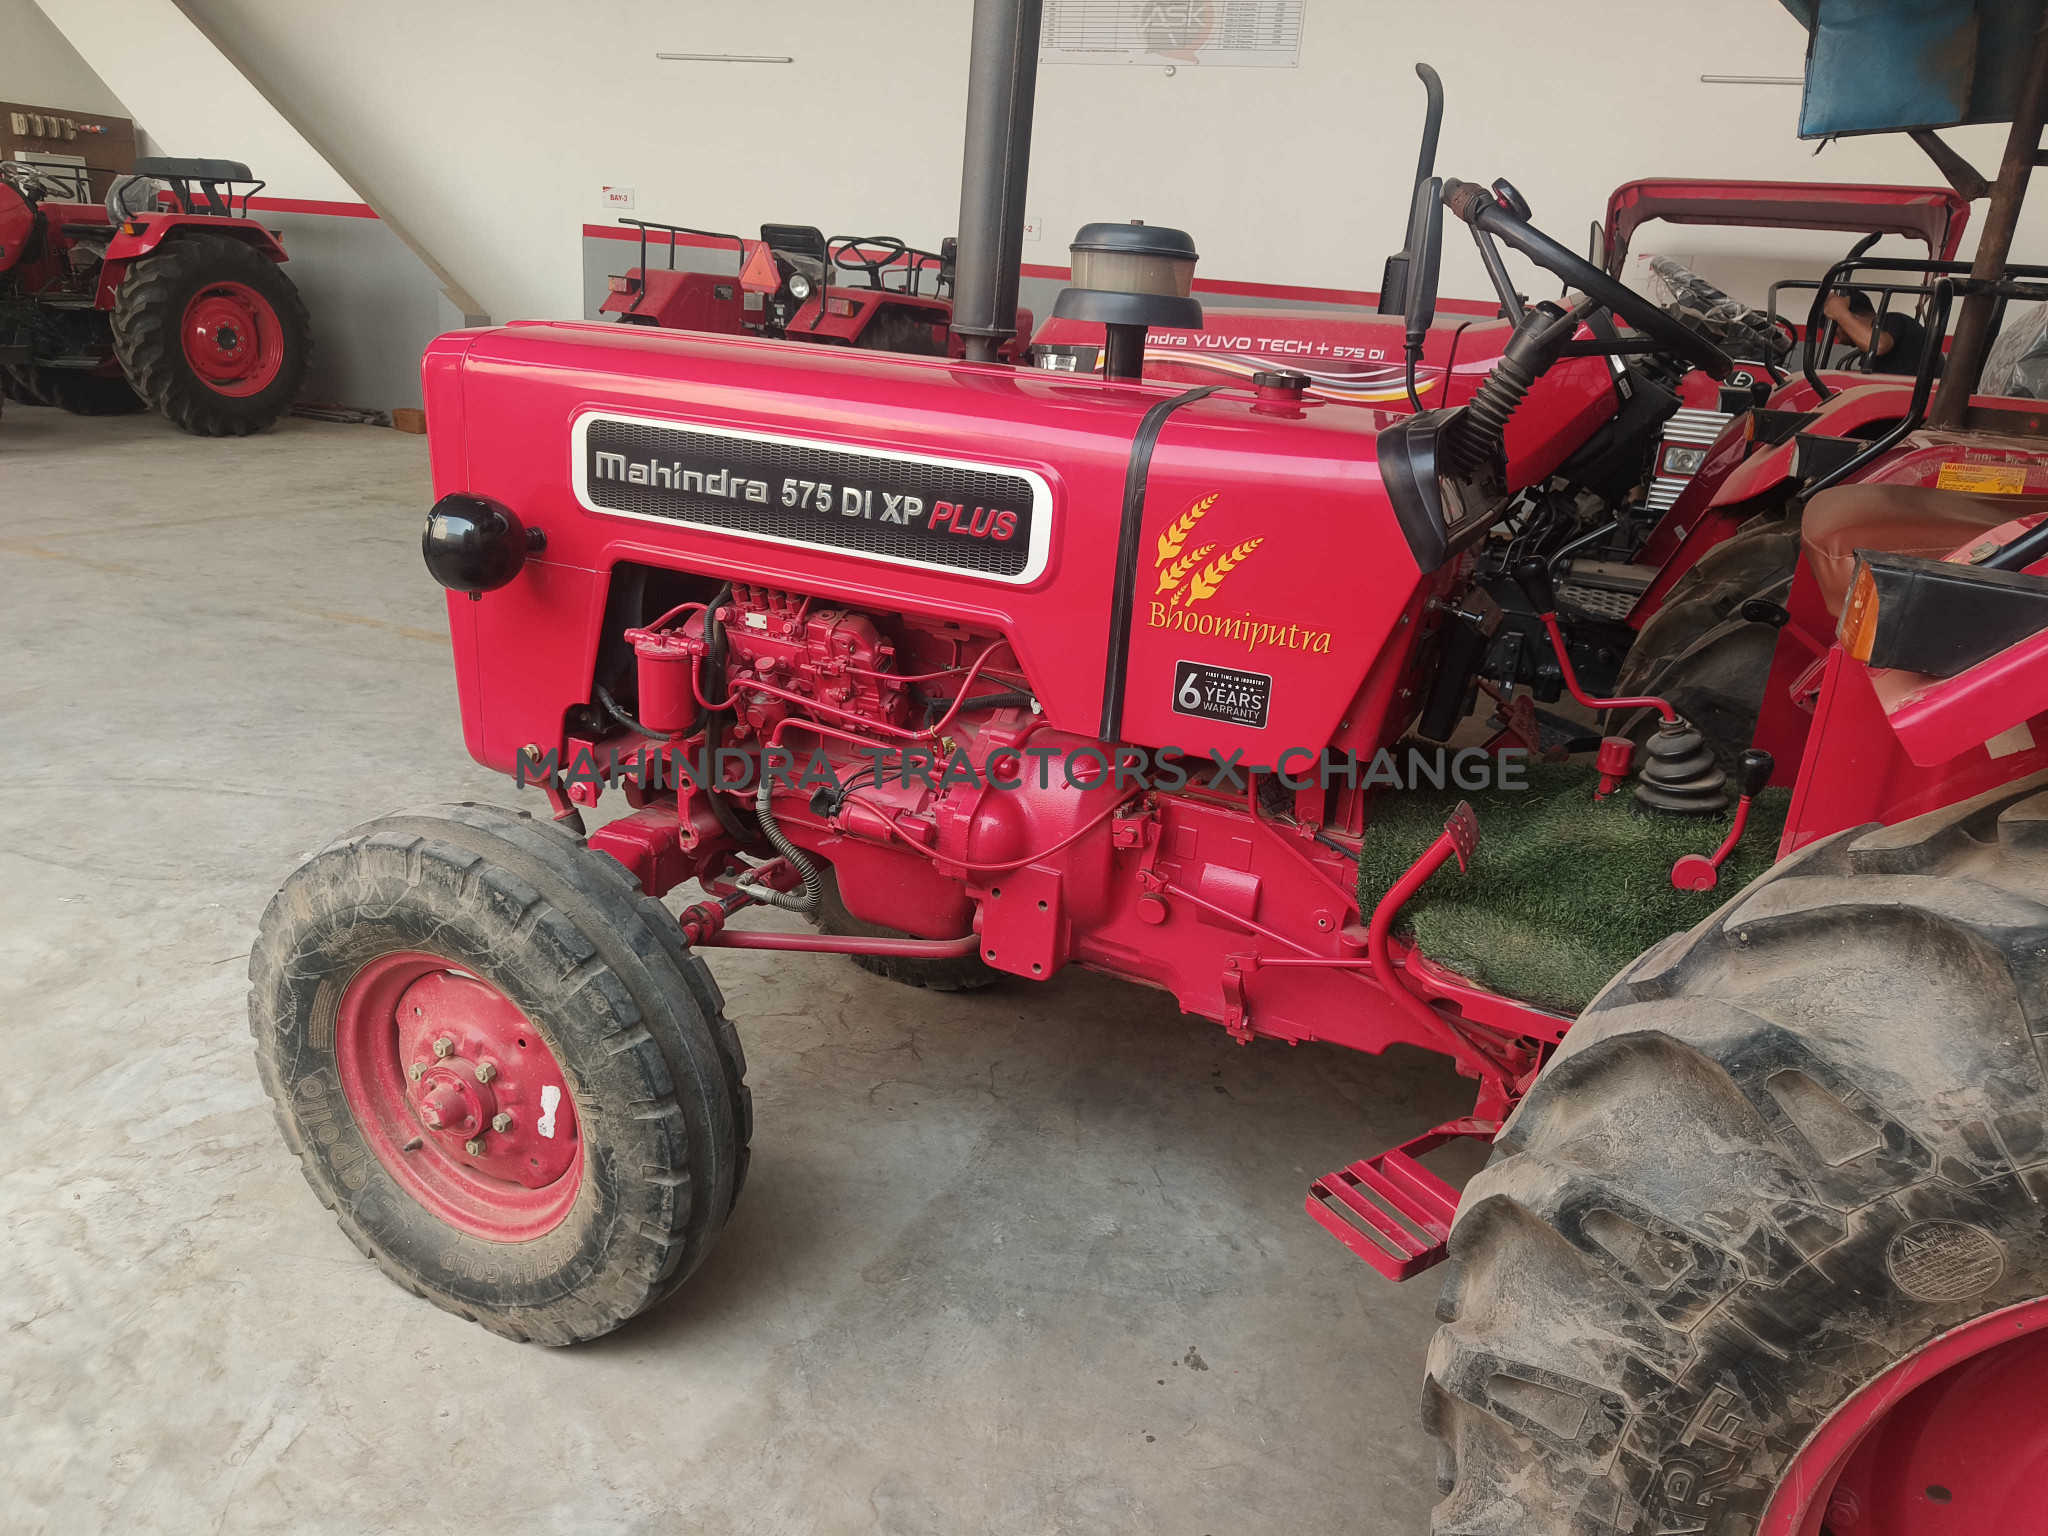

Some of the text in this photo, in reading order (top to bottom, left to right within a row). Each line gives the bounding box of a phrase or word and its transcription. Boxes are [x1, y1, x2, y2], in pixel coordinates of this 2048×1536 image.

[610, 194, 628, 202] BAY-3
[1145, 333, 1188, 346] indra
[1193, 335, 1252, 350] YUVO
[1257, 338, 1312, 354] TECH
[1333, 346, 1365, 358] 575
[1368, 349, 1385, 360] DI
[780, 478, 832, 513] 575
[841, 486, 873, 520] DI
[880, 492, 923, 526] XP
[927, 500, 1018, 541] PLUS
[1147, 600, 1331, 654] Bhoomiputra
[1178, 672, 1202, 709] 6
[1203, 701, 1260, 719] WARRANTY
[296, 1077, 368, 1190] apollo
[440, 1231, 584, 1285] KRISHAK GOLD
